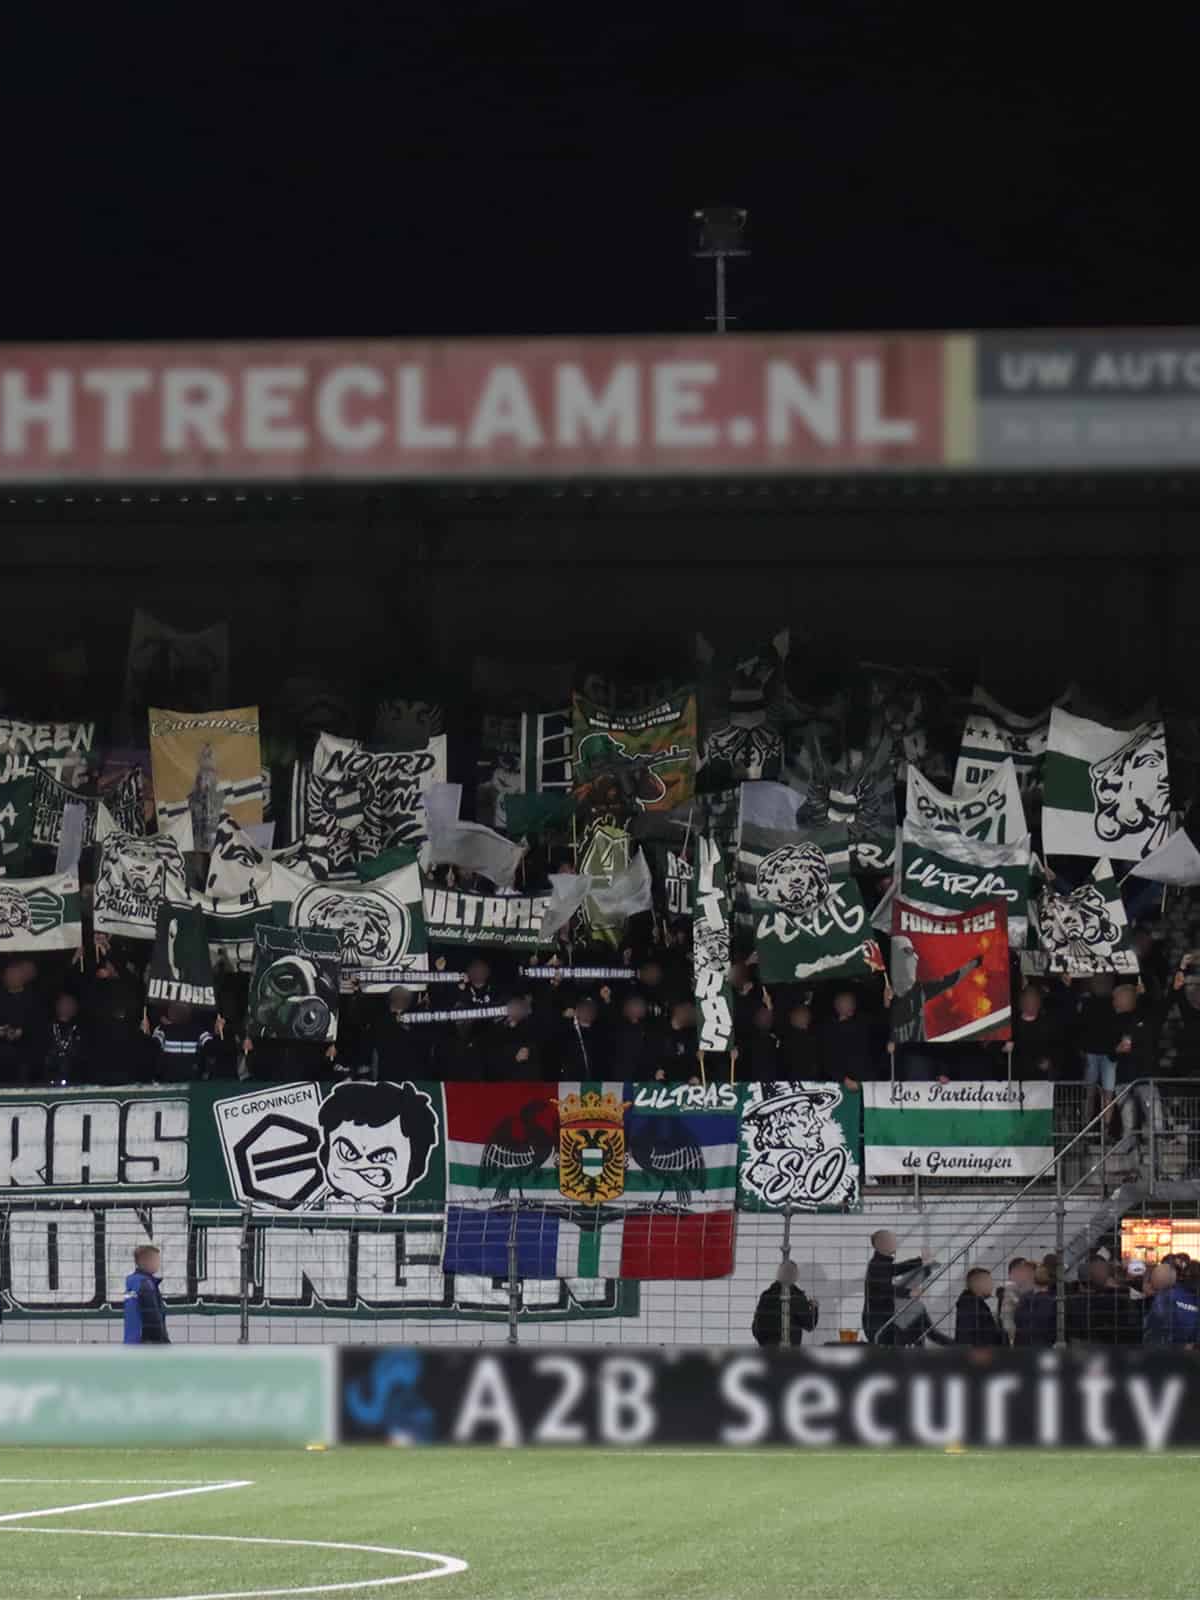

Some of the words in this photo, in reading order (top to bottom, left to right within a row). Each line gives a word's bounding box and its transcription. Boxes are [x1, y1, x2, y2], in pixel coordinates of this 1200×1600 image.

[322, 750, 436, 777] NOORD
[917, 789, 1008, 823] SINDS
[905, 856, 1019, 902] ULTRAS
[147, 978, 217, 1006] ULTRAS
[224, 1107, 240, 1120] FC
[242, 1090, 313, 1117] GRONINGEN
[634, 1086, 739, 1110] ULTRAS
[902, 1152, 922, 1169] de
[926, 1151, 1014, 1172] Groningen
[454, 1355, 658, 1448] A2B
[720, 1352, 1186, 1452] Security
